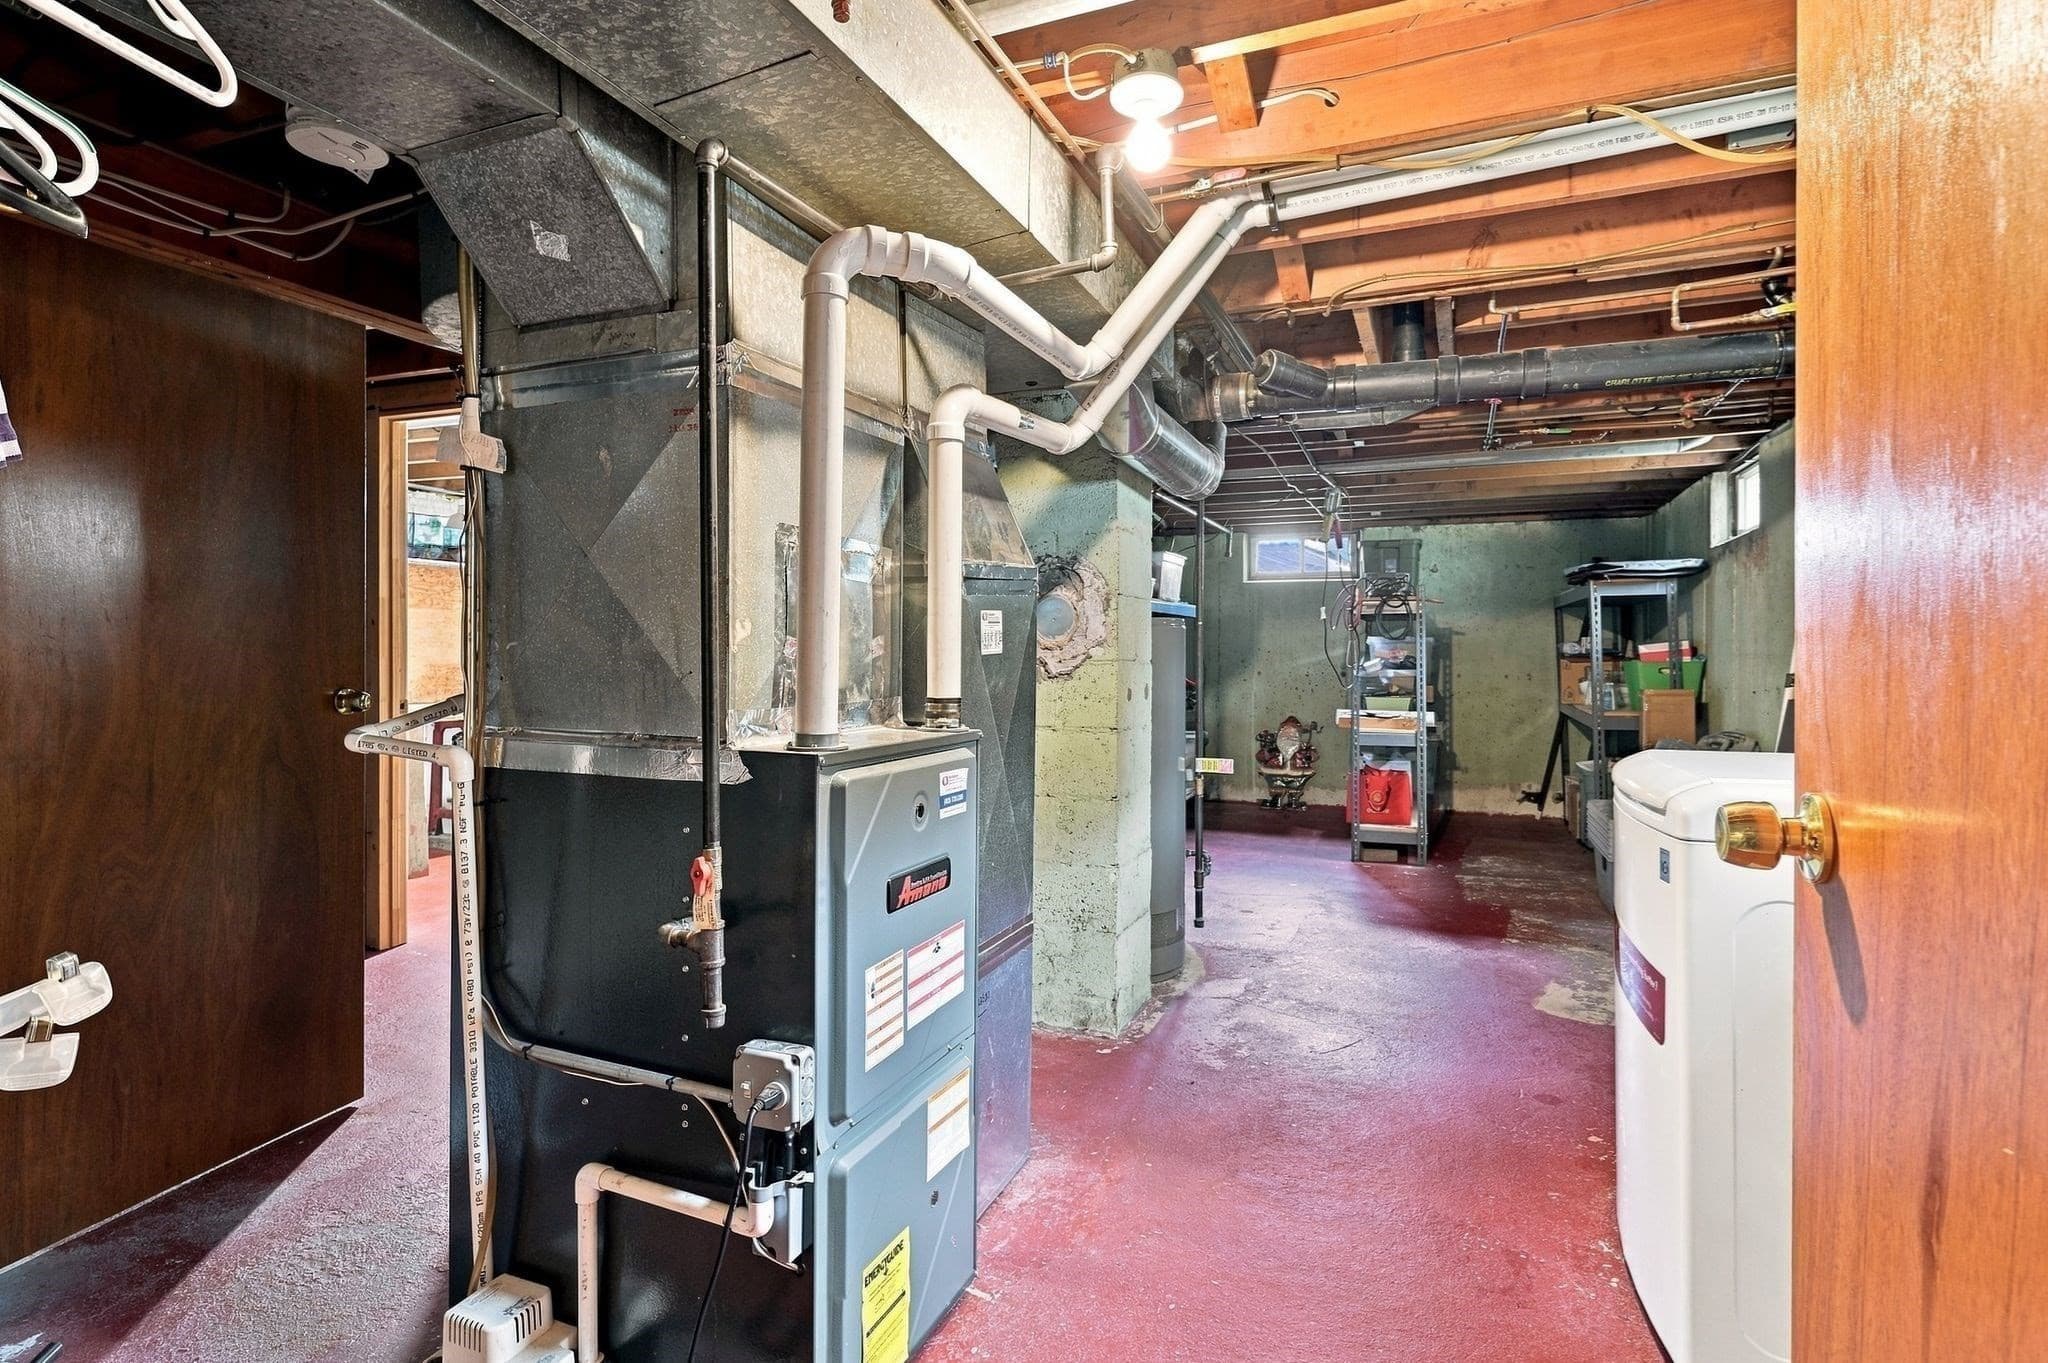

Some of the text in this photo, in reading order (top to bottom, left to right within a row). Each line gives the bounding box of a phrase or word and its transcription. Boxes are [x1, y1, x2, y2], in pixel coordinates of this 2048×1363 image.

[896, 875, 947, 908] Amana
[467, 1007, 476, 1026] kPa
[468, 1030, 477, 1052] 3310
[470, 1057, 479, 1098] POTABLE
[472, 1102, 480, 1124] 1120
[473, 1130, 481, 1147] PVC
[474, 1152, 482, 1164] 40
[475, 1168, 483, 1185] SCH
